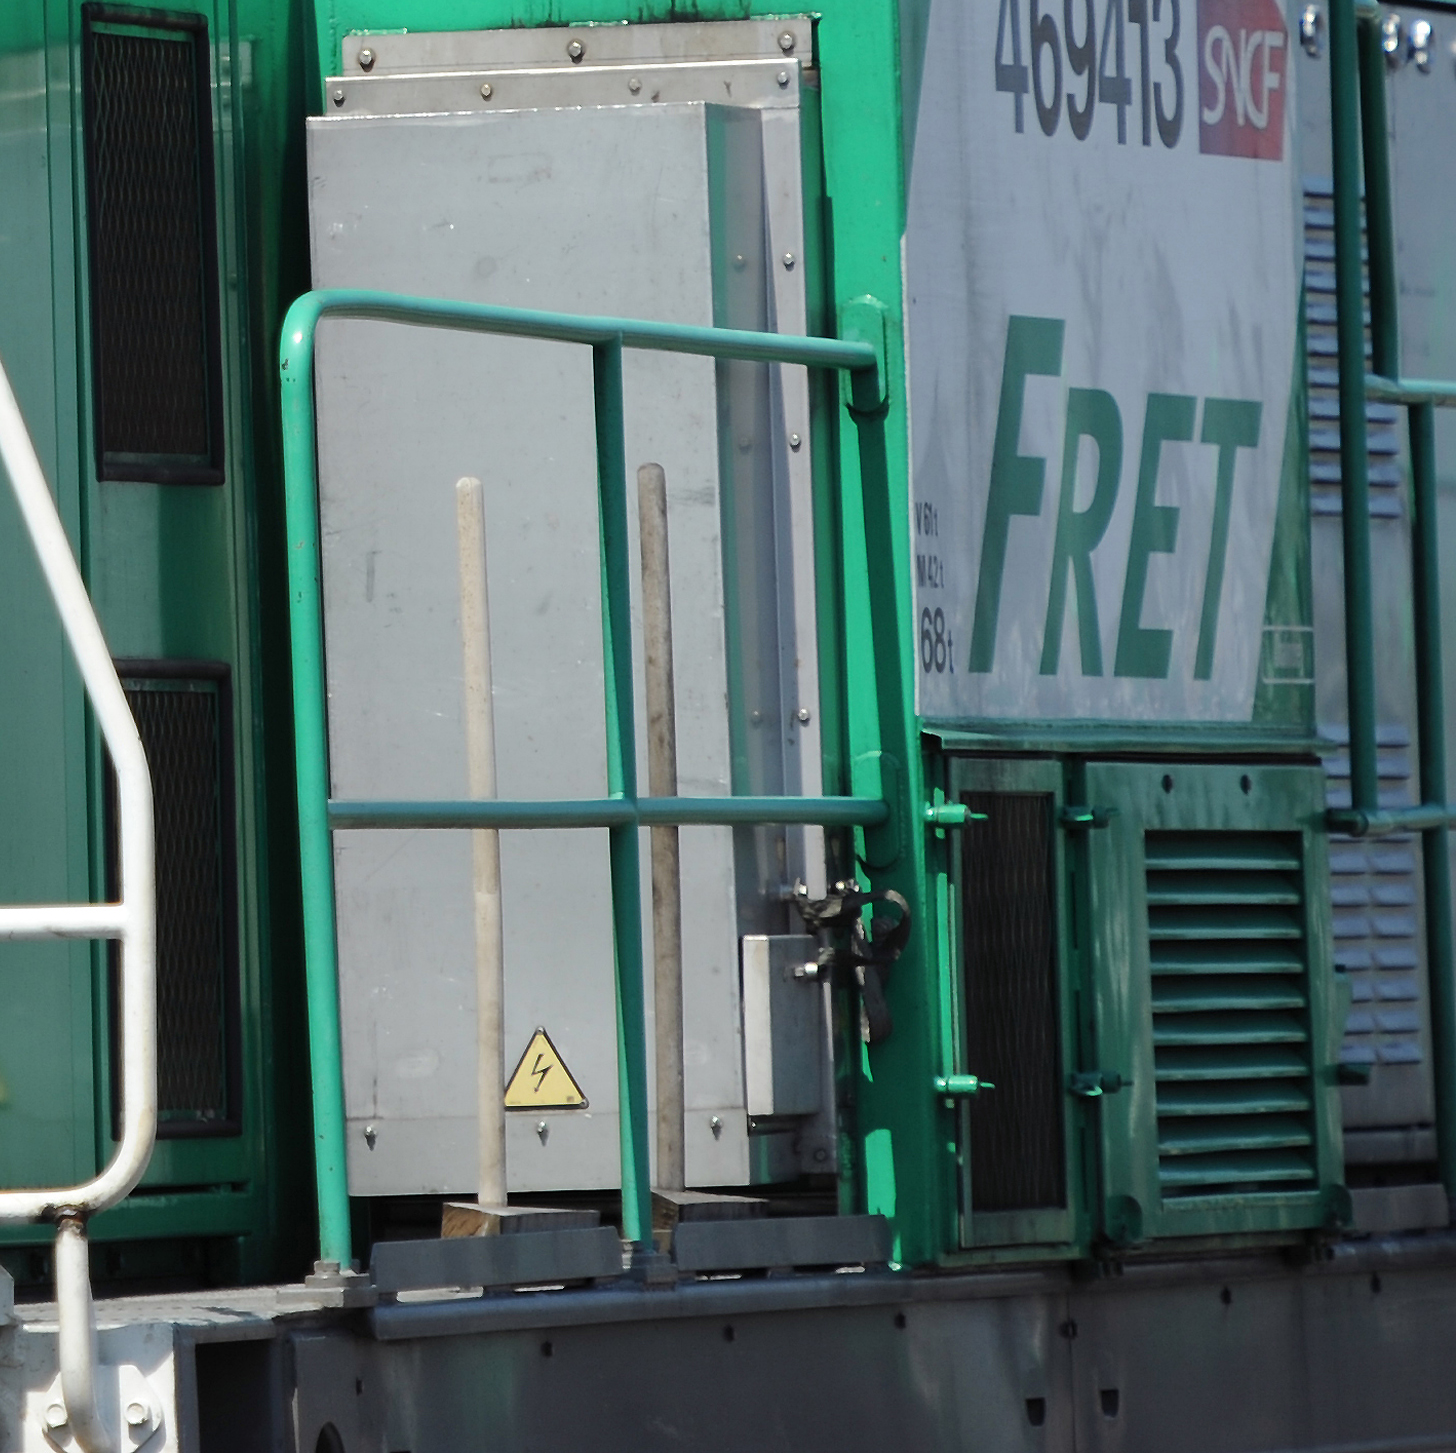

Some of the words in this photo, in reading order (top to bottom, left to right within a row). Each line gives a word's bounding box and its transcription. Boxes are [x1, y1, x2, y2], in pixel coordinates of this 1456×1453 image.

[1201, 24, 1287, 131] SNCF
[967, 314, 1264, 682] FRET
[920, 606, 955, 675] 68t
